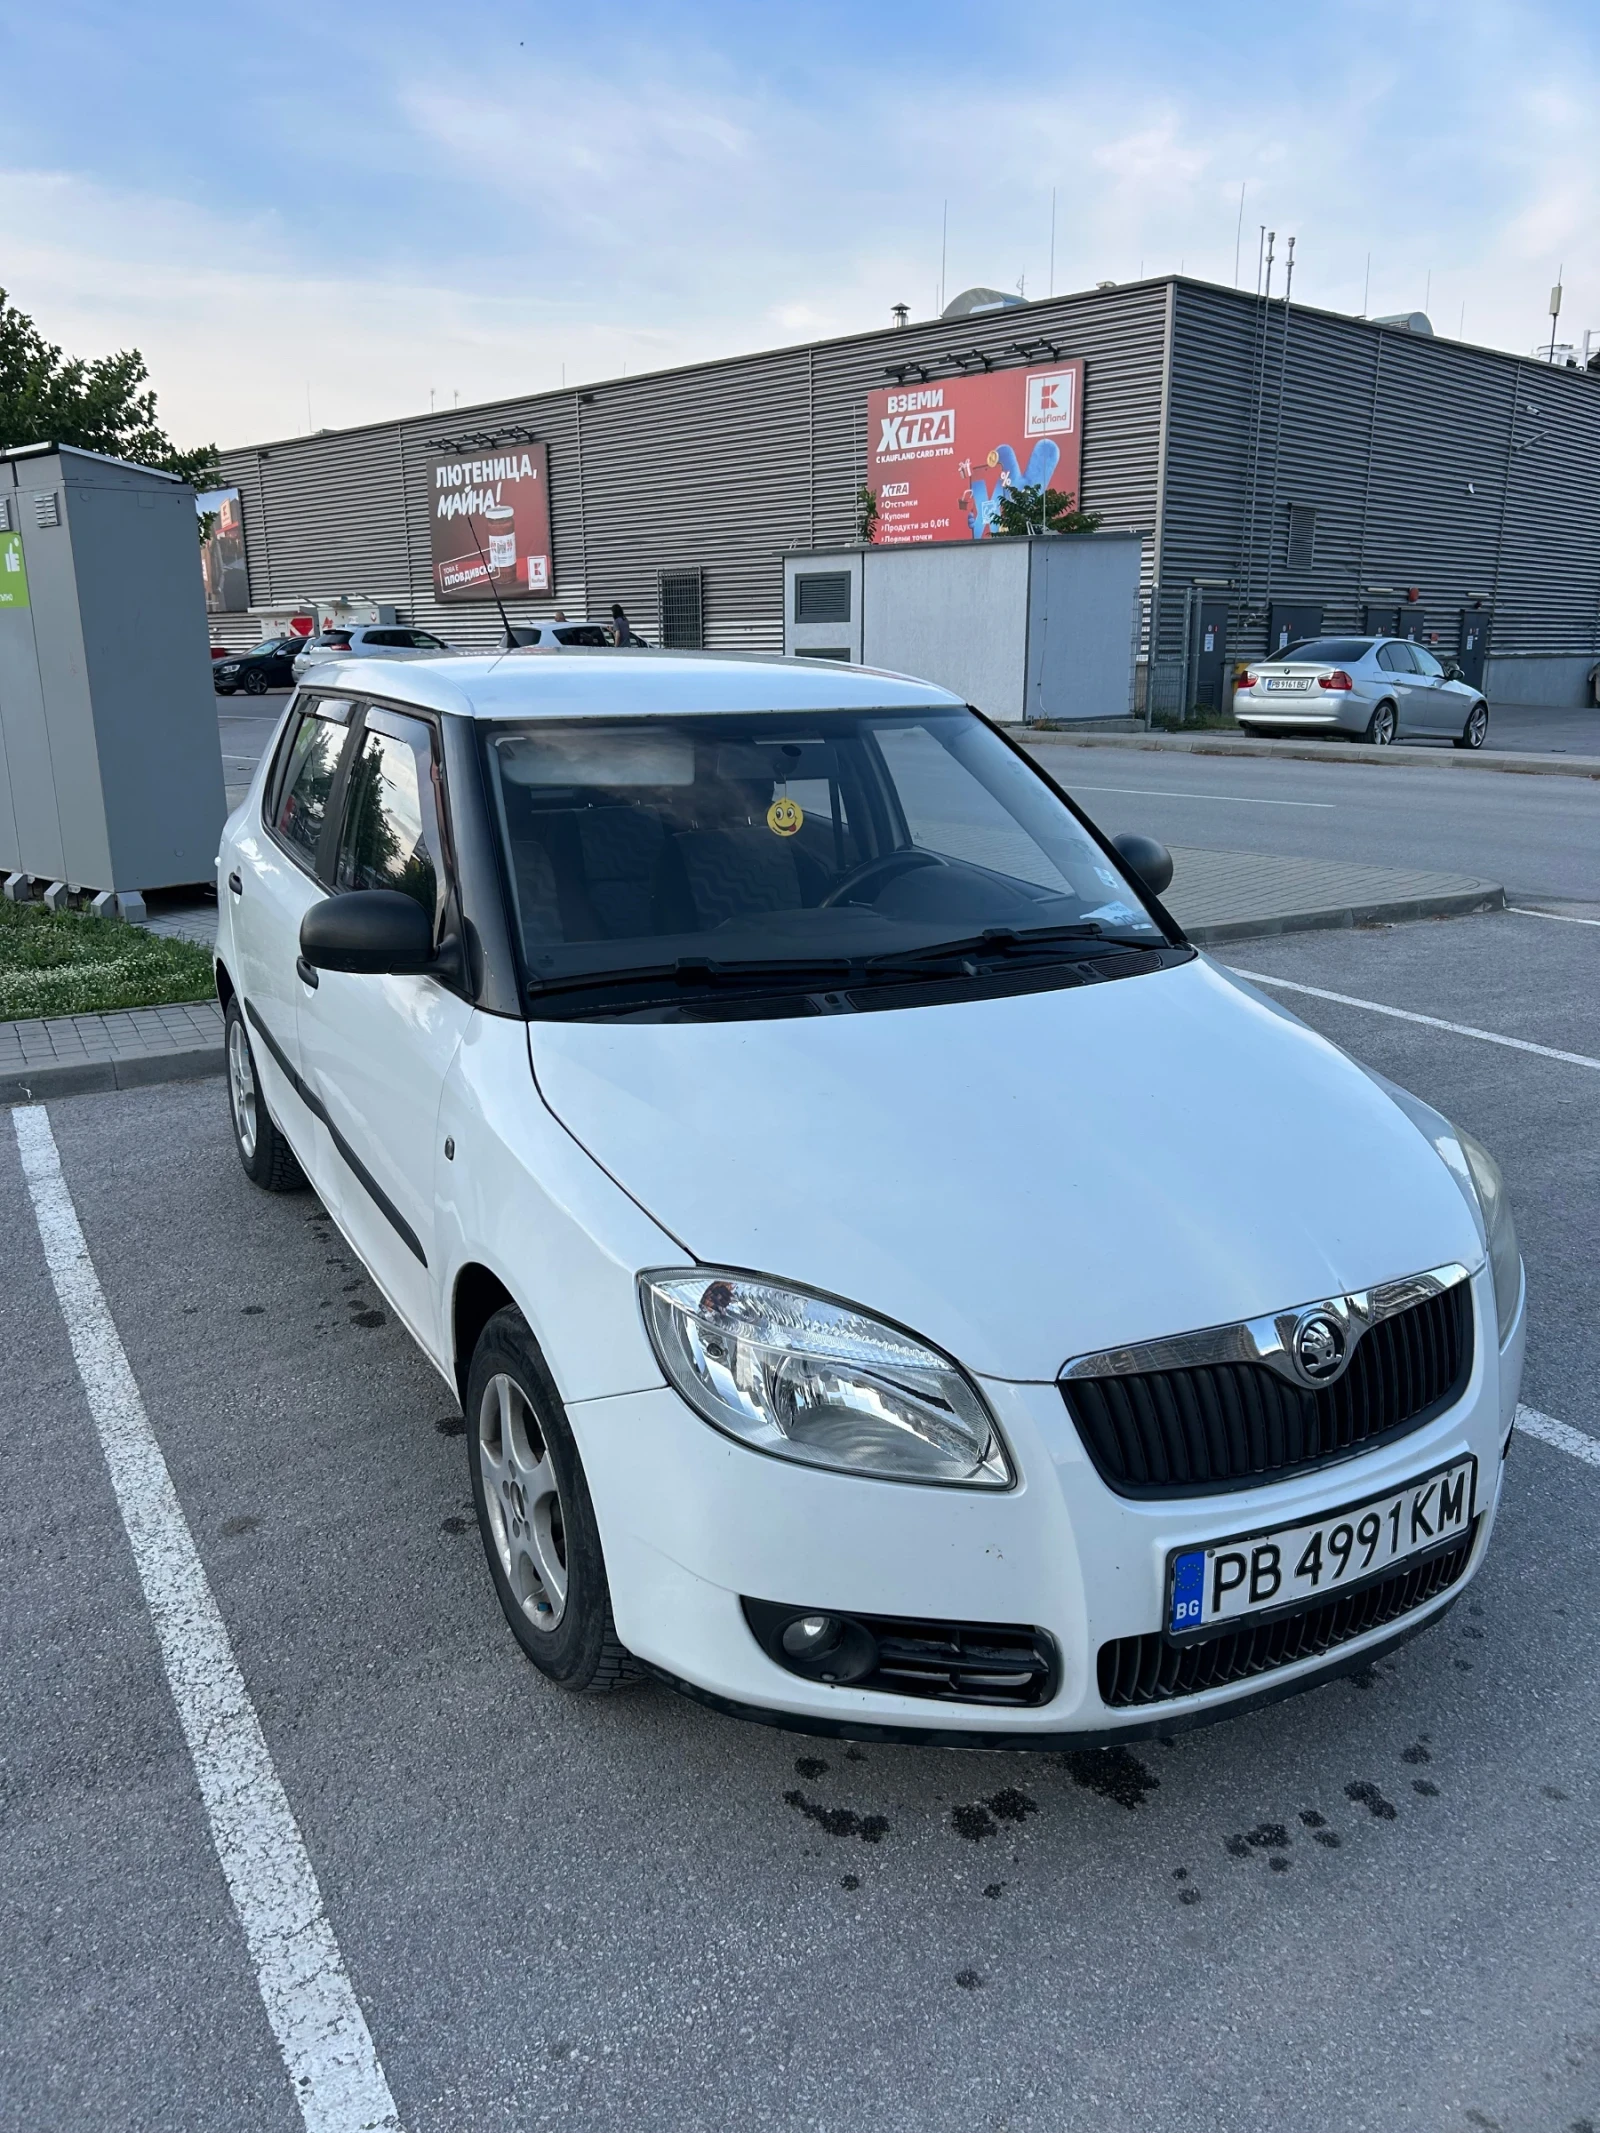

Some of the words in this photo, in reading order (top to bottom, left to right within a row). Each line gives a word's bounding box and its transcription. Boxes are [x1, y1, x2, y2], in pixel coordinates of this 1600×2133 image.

[887, 388, 944, 414] ВЗЕМИ
[1031, 411, 1067, 425] Kaufland
[876, 409, 955, 453] XTRA
[881, 452, 916, 463] KAUFLAND
[916, 449, 935, 458] CARD
[935, 447, 954, 456] XTRA
[436, 454, 538, 489] ЛЮТЕНИЦА,
[881, 482, 909, 498] XTRA
[437, 481, 502, 521] МАЙНА!
[884, 499, 918, 509] Отстъпки
[884, 512, 910, 522] Купони
[884, 523, 919, 533] Продукти
[930, 519, 950, 529] 0,01€
[1212, 1542, 1282, 1614] PB
[1294, 1499, 1402, 1587] 4991
[1411, 1470, 1466, 1545] KM
[1175, 1599, 1200, 1621] BG
